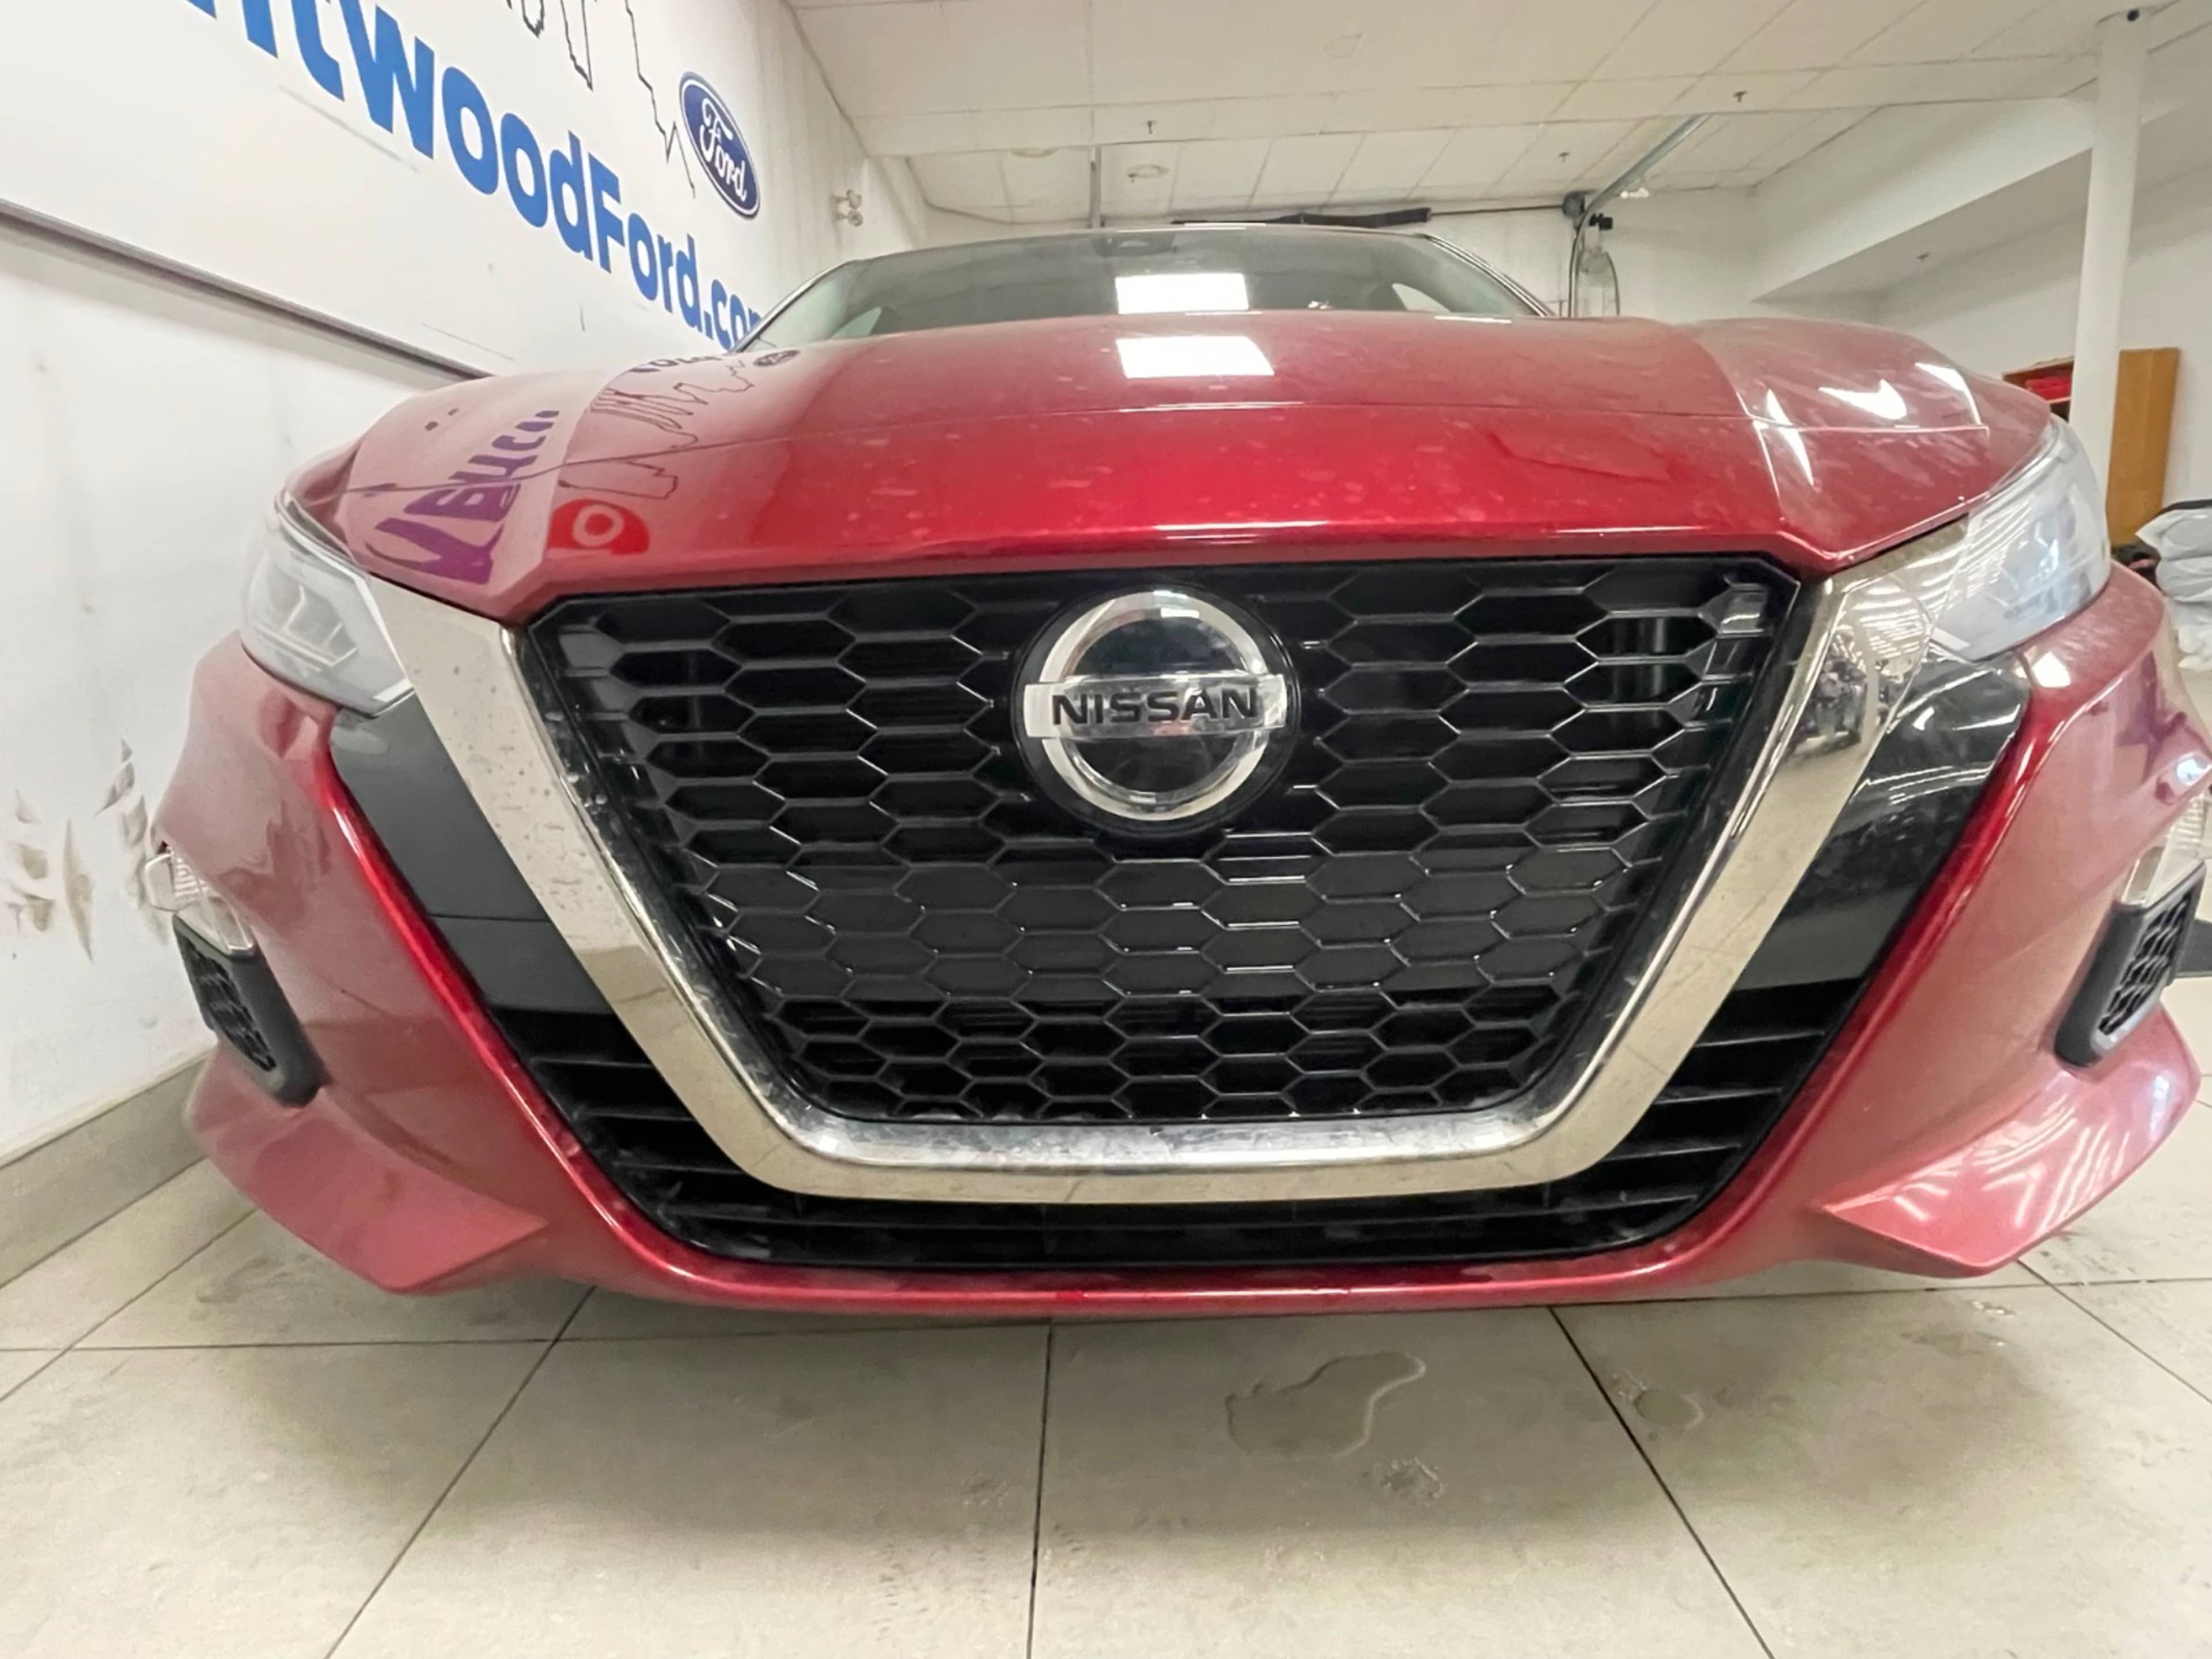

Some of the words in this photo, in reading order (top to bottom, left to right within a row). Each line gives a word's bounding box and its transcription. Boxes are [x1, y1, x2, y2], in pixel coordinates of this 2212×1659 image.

[182, 0, 762, 351] woodFord.co
[699, 97, 748, 202] Ford
[1052, 688, 1257, 725] NISSAN
